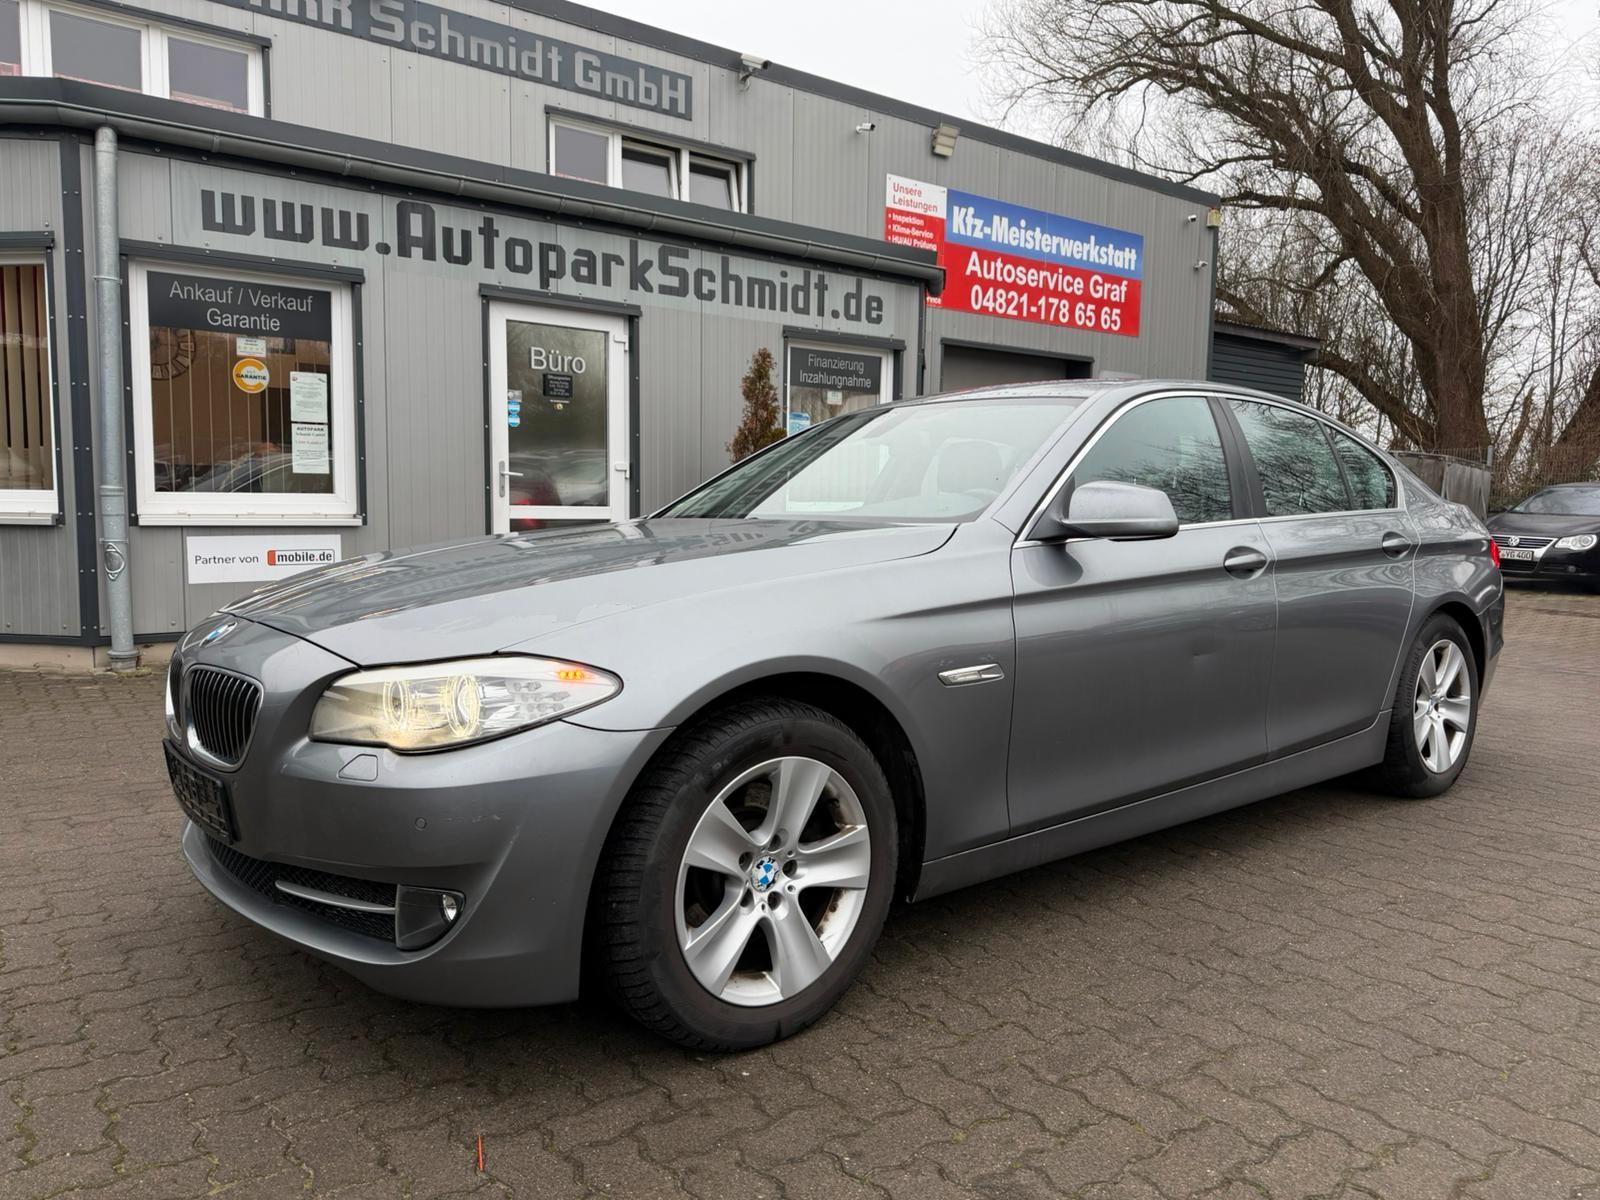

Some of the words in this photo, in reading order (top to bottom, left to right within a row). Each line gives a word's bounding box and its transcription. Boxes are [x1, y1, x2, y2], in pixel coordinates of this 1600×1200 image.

[370, 0, 562, 83] Schmidt
[574, 51, 686, 115] GmbH
[892, 182, 922, 198] Unsere
[892, 194, 938, 213] Leistungen
[892, 213, 925, 226] Inspektion
[892, 224, 934, 239] Klima-Service
[952, 205, 1137, 271] Kfz-Meisterwerkstatt
[201, 190, 884, 325] www.AutoparkSchmidt.de
[965, 251, 1084, 296] Autoservice
[1089, 274, 1128, 303] Graf
[169, 280, 234, 304] Ankauf
[237, 287, 244, 305] /
[249, 289, 314, 312] Verkauf
[970, 284, 1070, 324] 04821-178
[1074, 302, 1096, 327] 65
[1100, 306, 1121, 331] 65
[206, 308, 281, 331] Garantie
[530, 346, 587, 374] Büro
[808, 353, 865, 374] Finanzierung
[800, 370, 872, 388] Inzahlungnahme
[194, 555, 236, 565] Partner
[239, 555, 259, 564] von
[277, 551, 333, 563] mobile.de
